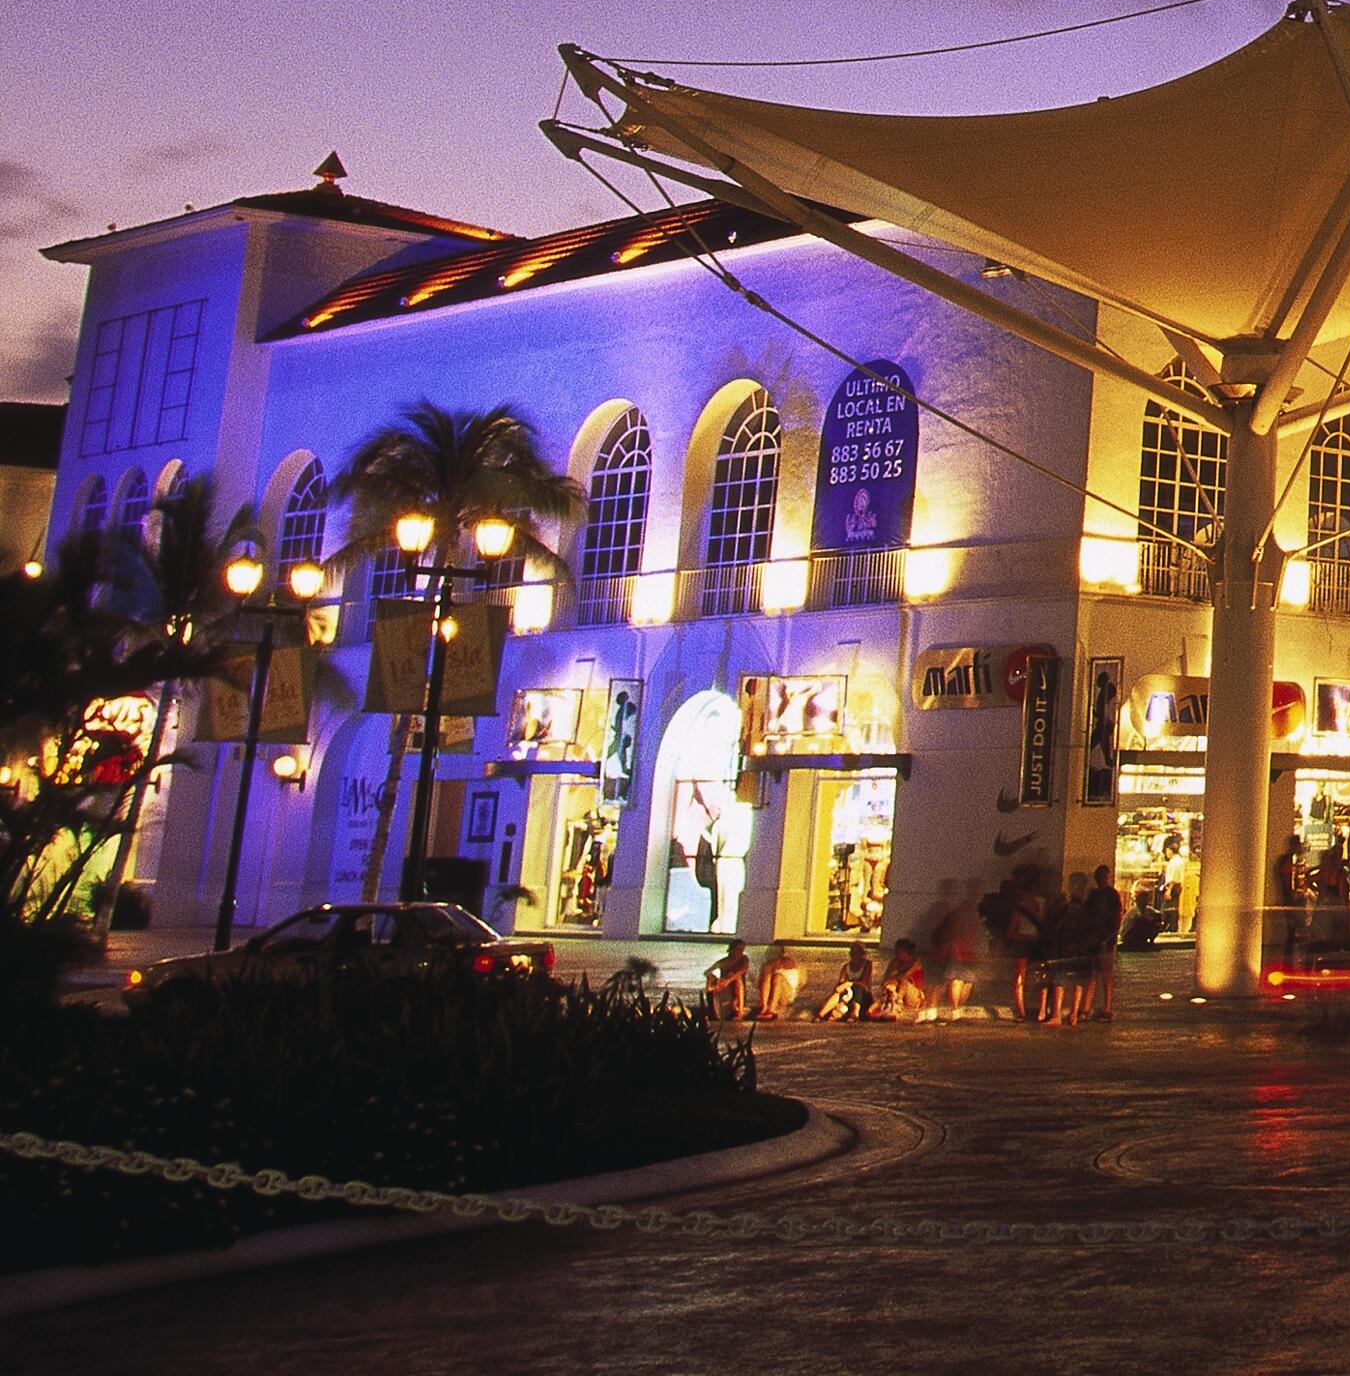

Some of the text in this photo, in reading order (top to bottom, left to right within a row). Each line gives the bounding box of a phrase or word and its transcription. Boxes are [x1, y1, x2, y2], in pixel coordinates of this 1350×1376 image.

[837, 395, 906, 419] LOCAL EN
[846, 417, 892, 439] RENTA
[831, 444, 859, 464] 883
[884, 439, 905, 458] 67
[829, 458, 903, 485] 883 50 25
[1031, 697, 1048, 796] JUST DO IT
